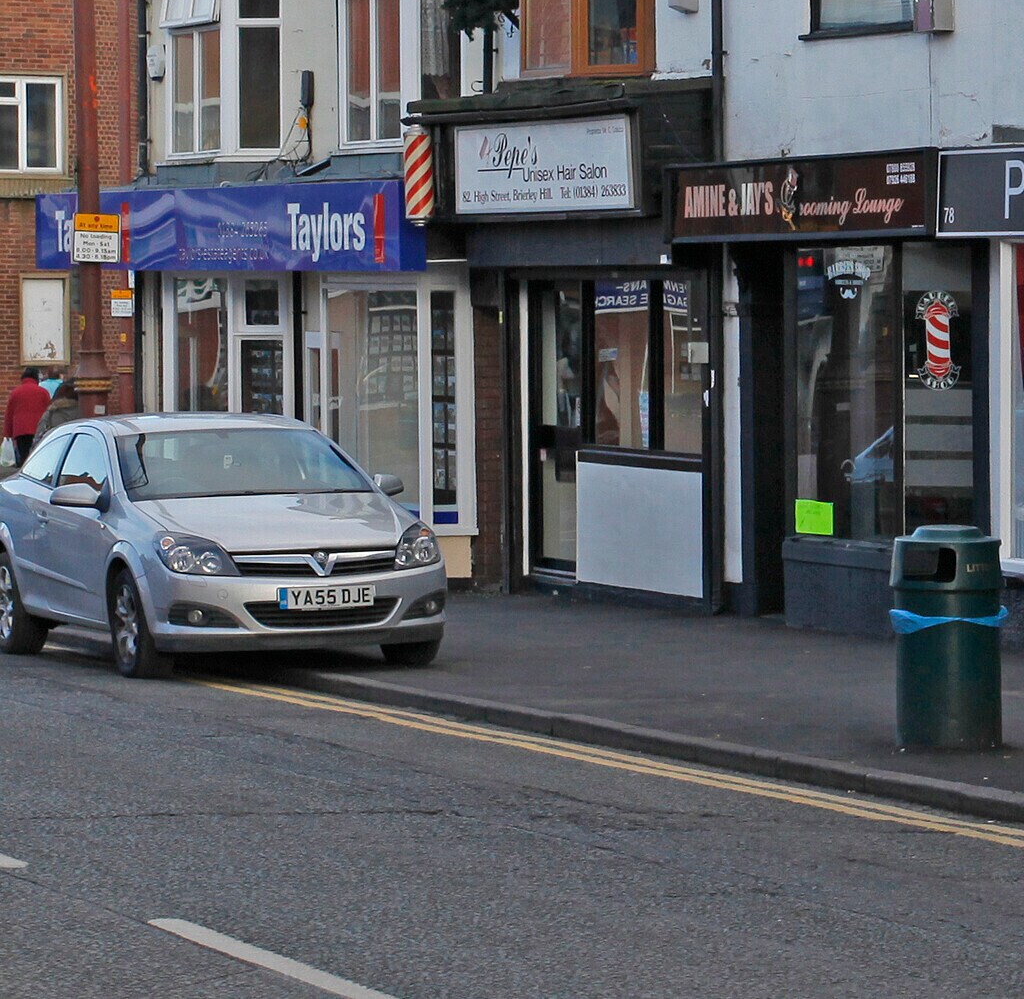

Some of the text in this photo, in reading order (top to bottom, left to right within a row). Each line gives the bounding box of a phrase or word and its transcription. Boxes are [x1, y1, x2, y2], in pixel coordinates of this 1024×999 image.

[492, 133, 537, 178] Pepe's
[522, 163, 608, 182] Unisex Hair Salon
[462, 190, 471, 202] 82
[474, 190, 489, 204] High
[513, 187, 537, 203] Brierley
[684, 181, 774, 218] AMINE & JAY'S
[852, 187, 905, 224] Lounge
[944, 207, 955, 223] 78
[287, 202, 365, 262] Taylors
[926, 377, 954, 390] SHOP
[291, 587, 370, 606] YA55 DJE
